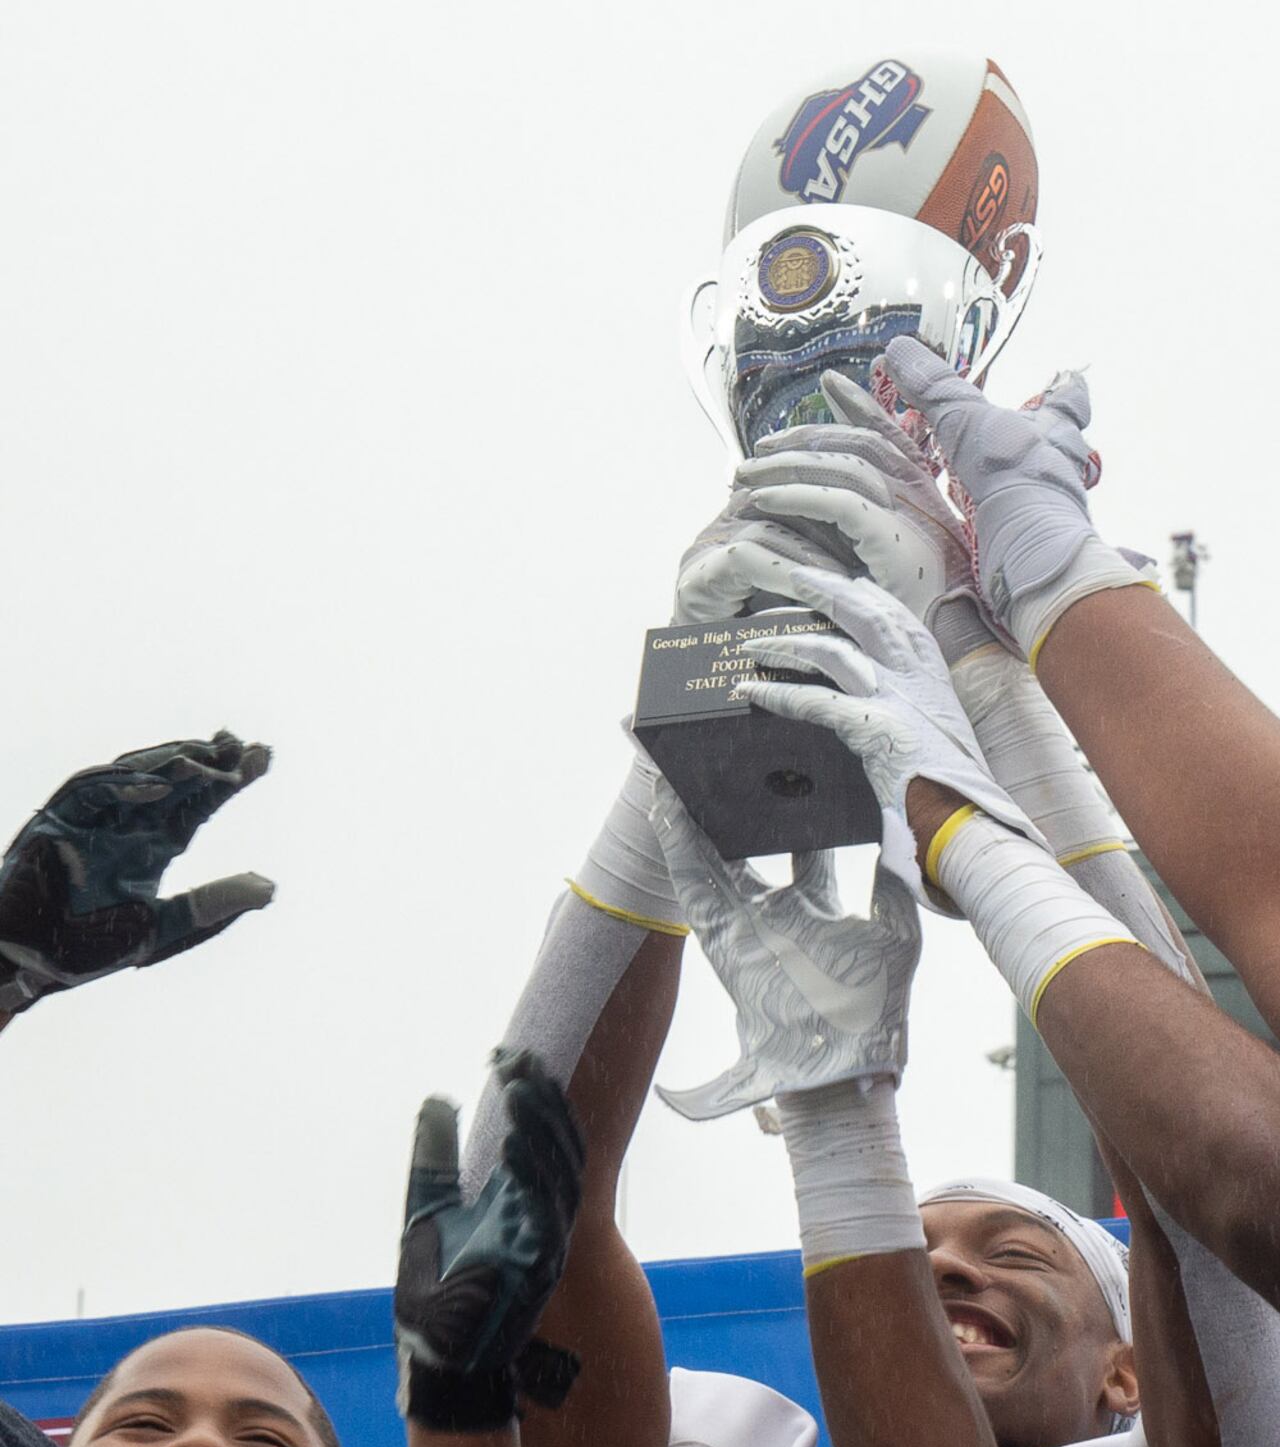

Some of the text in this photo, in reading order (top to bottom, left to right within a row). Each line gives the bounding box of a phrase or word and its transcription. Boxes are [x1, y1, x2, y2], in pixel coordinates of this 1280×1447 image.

[803, 59, 907, 203] GHSA
[652, 636, 698, 651] Georgia
[703, 630, 732, 645] High
[736, 625, 778, 640] School
[711, 658, 758, 673] FOOTB
[685, 674, 728, 692] STATE
